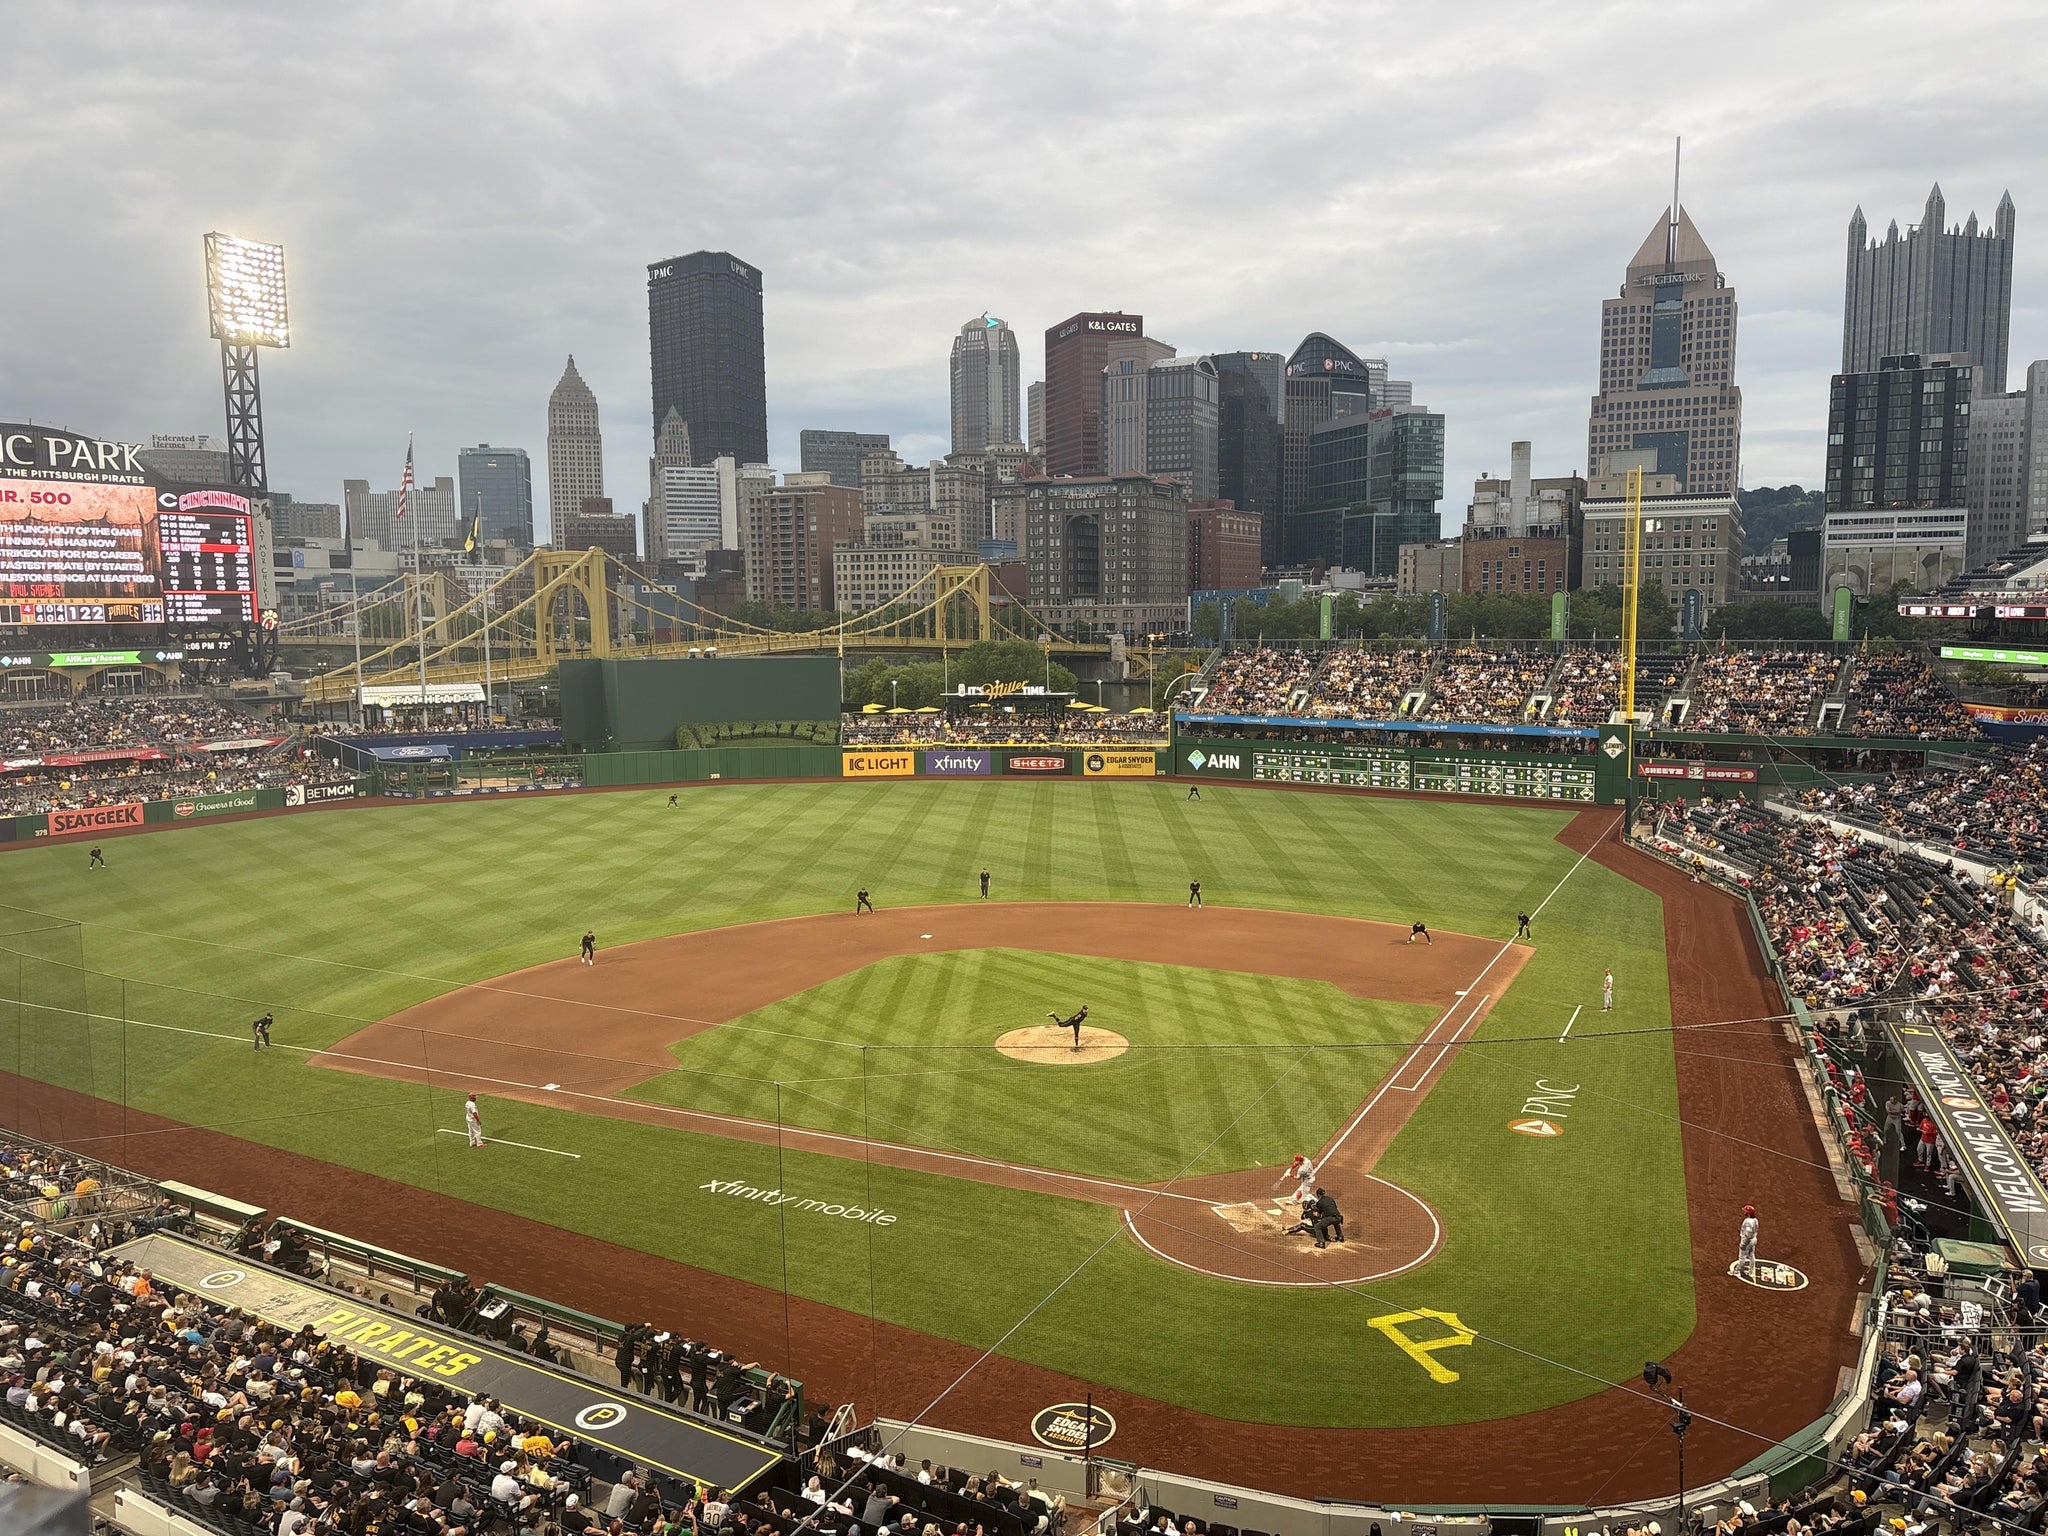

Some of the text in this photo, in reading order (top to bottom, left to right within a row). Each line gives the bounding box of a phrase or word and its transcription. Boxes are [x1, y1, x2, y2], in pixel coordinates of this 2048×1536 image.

[648, 266, 673, 280] UPMC
[730, 261, 748, 279] UPMC
[1644, 272, 1702, 286] HIGHMARK
[1088, 321, 1136, 332] K&L GATES
[1293, 362, 1305, 372] PNC
[1335, 360, 1352, 371] PNC
[152, 434, 195, 442] Federated
[0, 434, 145, 473] C PARK
[6, 468, 145, 484] THE PITTSBURGH PIRATES
[0, 490, 72, 505] R. 500
[179, 490, 250, 514] CINCINNATI
[14, 525, 76, 535] PUNCHOUT
[76, 527, 90, 536] OF
[90, 528, 110, 537] THE
[111, 528, 143, 537] GAME
[6, 537, 117, 548] INNING, HE HAS NOW
[60, 550, 82, 560] FOR
[82, 551, 100, 560] HIS
[100, 552, 144, 562] CAREER,
[1, 562, 144, 572] FASTEST PIRATE (BY STARTS)
[53, 574, 86, 583] SINCE
[86, 575, 102, 583] AT
[102, 575, 132, 583] LEAST
[132, 575, 155, 584] 1893
[10, 584, 28, 597] PAUL
[262, 568, 270, 606] CHIKIN
[36, 604, 43, 612] 6
[46, 604, 54, 612] 0
[57, 604, 64, 612] 4
[69, 607, 76, 620] 1
[80, 607, 91, 620] 2
[92, 607, 104, 620] 2
[108, 605, 139, 620] PIRATES
[144, 604, 152, 612] 2
[36, 614, 44, 622] 4
[46, 614, 54, 622] 0
[57, 614, 64, 622] 4
[145, 614, 152, 622] 2
[154, 614, 162, 622] 2
[202, 642, 232, 650] PM 73°
[12, 656, 32, 666] AHN
[65, 654, 125, 664] AHN.org/Access
[166, 652, 182, 660] AHN
[968, 680, 1045, 701] IT'S Miller TIME
[396, 694, 476, 705] FAT HEAD'S
[400, 747, 425, 756] Ford
[850, 758, 908, 770] IC LIGHT
[934, 755, 982, 772] xfinity
[1208, 754, 1240, 770] AHN
[1436, 757, 1506, 765] AMERICAN
[1689, 767, 1703, 776] 52
[306, 784, 354, 799] BETMGM
[196, 802, 228, 812] Growers
[234, 796, 255, 806] Good
[55, 806, 138, 832] SEATGEEK
[1520, 1079, 1580, 1118] PNC
[1916, 1050, 2047, 1214] WELCOME TO PNC PARK
[699, 1180, 897, 1226] xfinity mobile
[309, 1309, 482, 1376] PIRATES
[1367, 1307, 1480, 1384] P
[587, 1408, 615, 1422] P
[1046, 1424, 1088, 1440] SNYDER
[1048, 1432, 1085, 1446] ASSOCIATES
